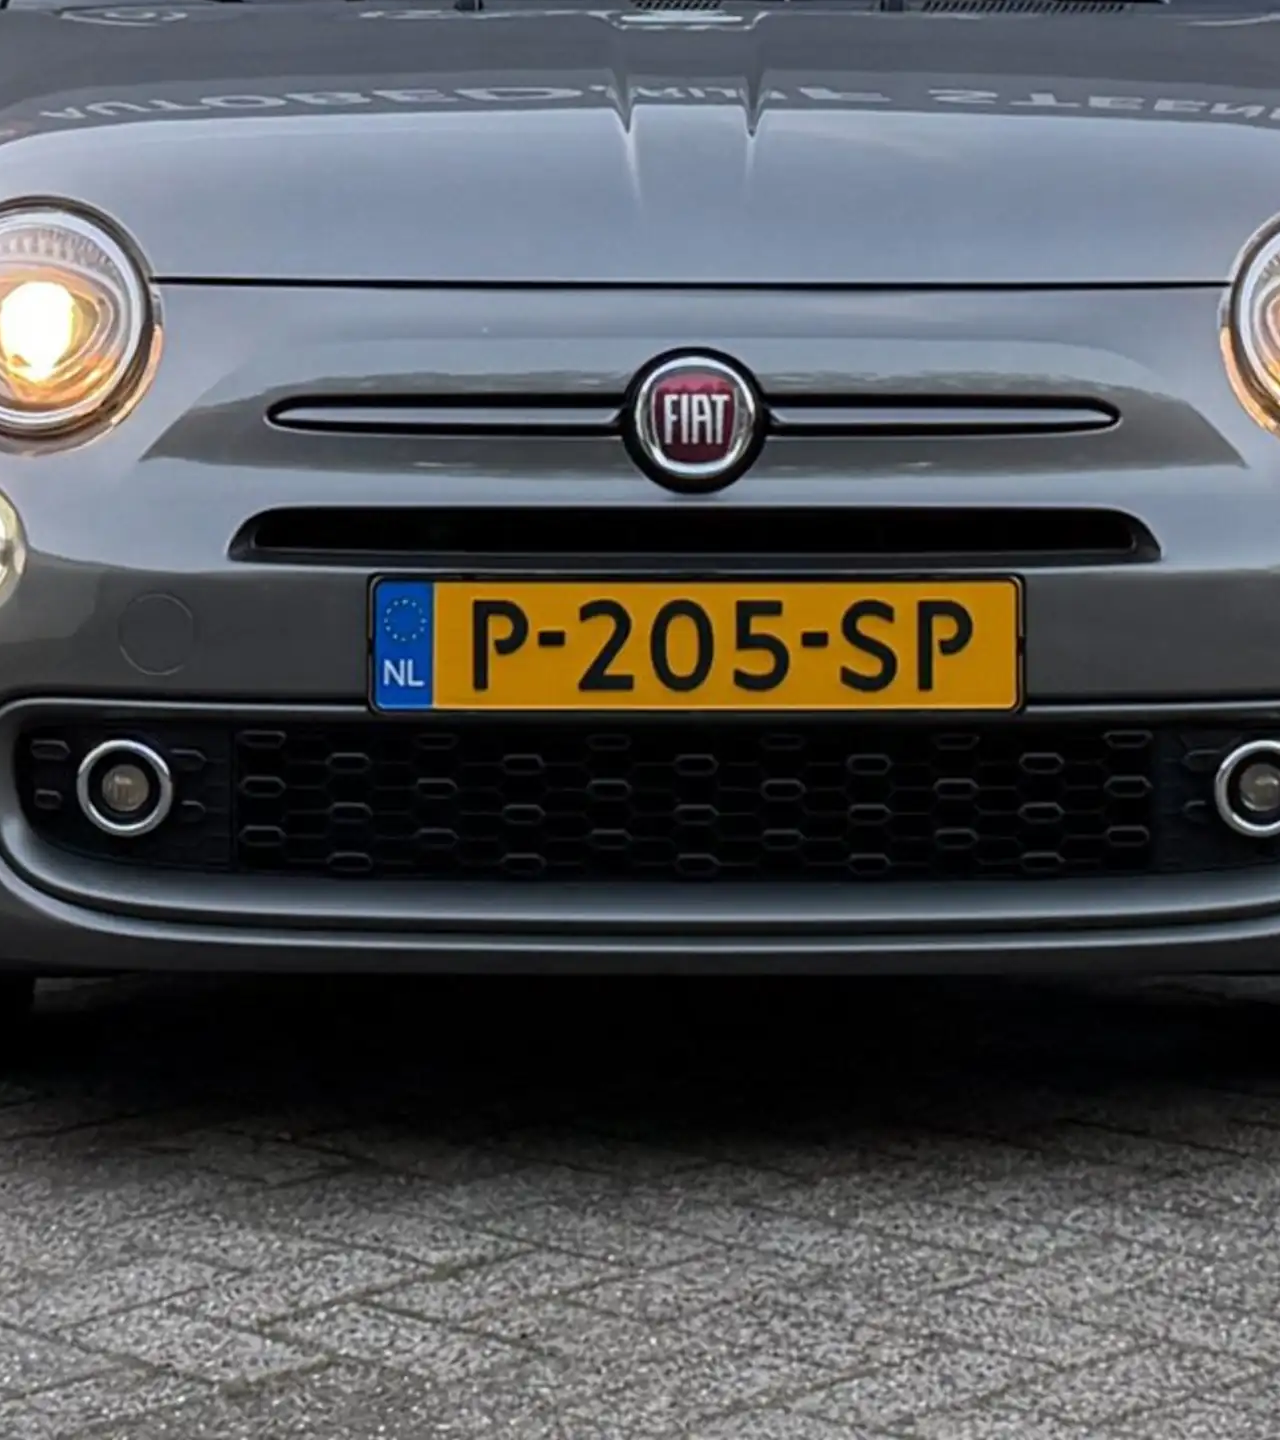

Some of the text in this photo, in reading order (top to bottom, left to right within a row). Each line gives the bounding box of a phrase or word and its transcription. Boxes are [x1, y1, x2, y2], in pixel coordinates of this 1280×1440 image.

[663, 393, 732, 445] FIAT
[383, 598, 975, 694] NL P-205-SP
